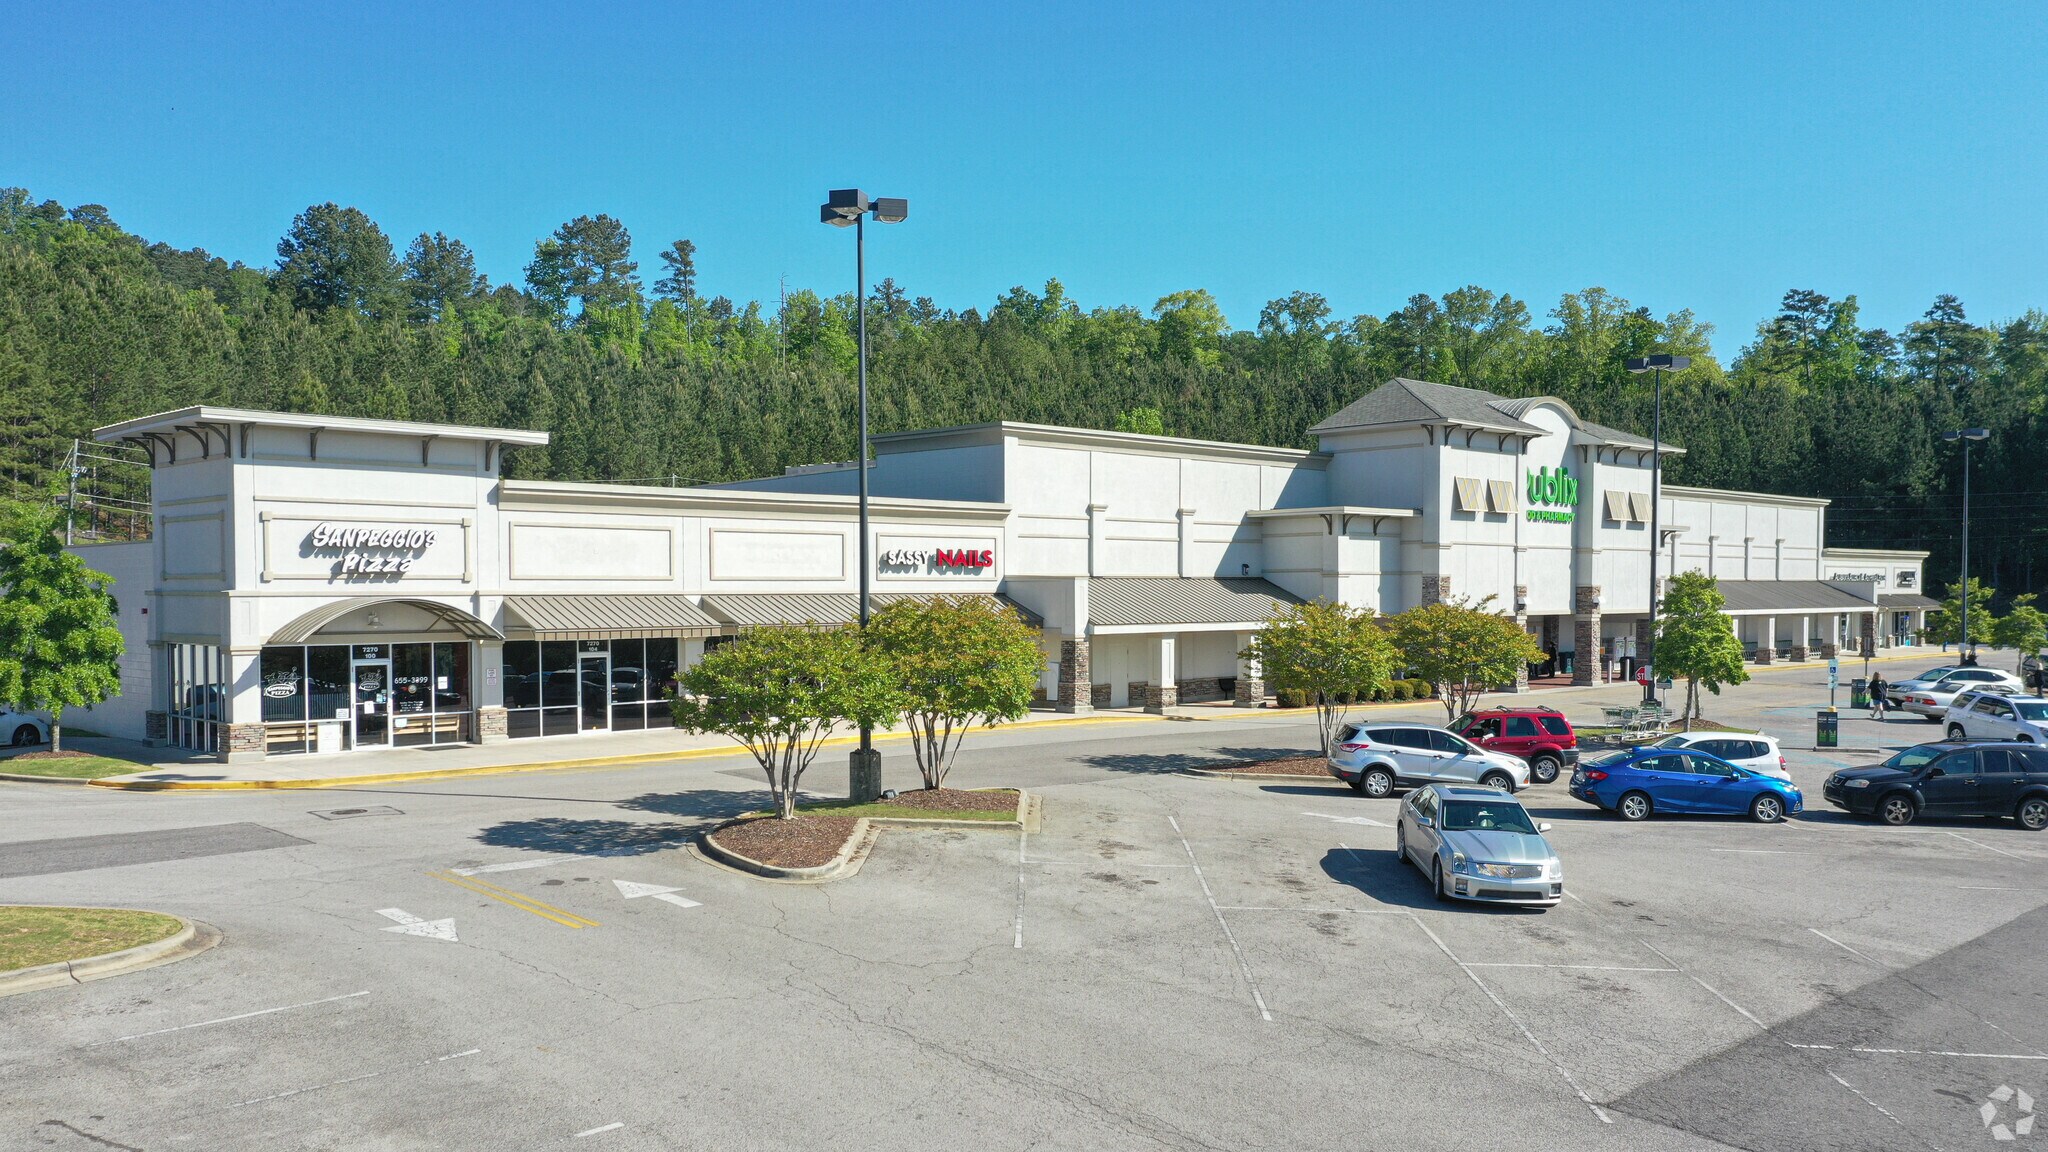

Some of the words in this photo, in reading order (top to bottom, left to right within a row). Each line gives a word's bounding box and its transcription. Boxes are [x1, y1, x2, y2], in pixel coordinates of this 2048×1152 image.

[1542, 511, 1576, 522] PHARMACY
[313, 522, 437, 549] SANPEGGIO'S
[342, 552, 414, 573] Pizza
[887, 550, 928, 565] SASSY
[936, 549, 993, 567] NAILS
